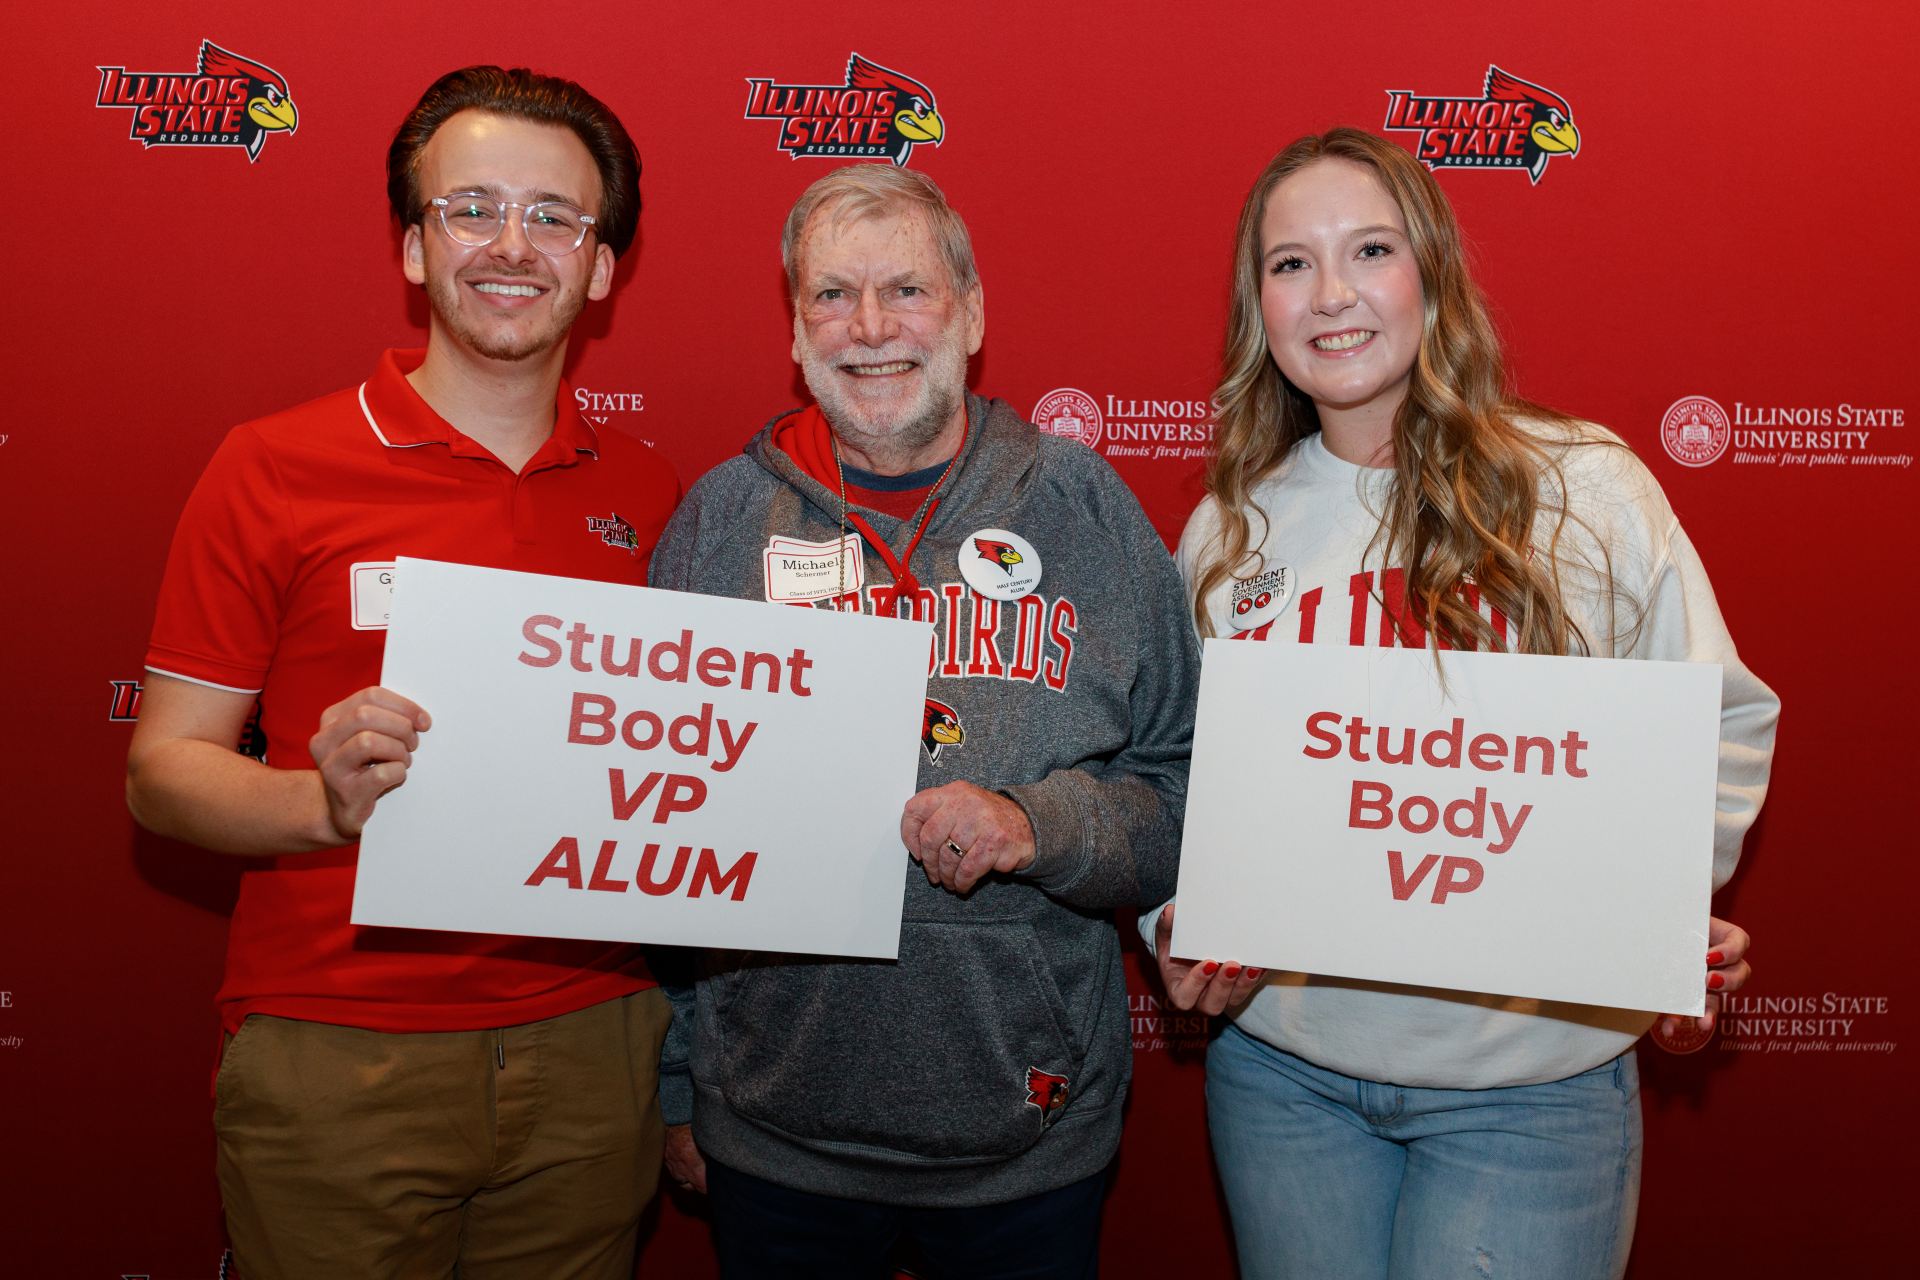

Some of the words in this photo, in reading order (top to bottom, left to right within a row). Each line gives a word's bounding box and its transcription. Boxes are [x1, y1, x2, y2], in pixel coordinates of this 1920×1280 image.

[100, 69, 251, 105] ILLINOIS
[748, 81, 899, 118] ILLINOIS
[1387, 92, 1535, 129] ILLINOIS
[135, 104, 245, 136] STATE
[783, 116, 893, 148] STATE
[159, 134, 240, 143] REDBIRDS
[806, 145, 887, 154] REDBIRDS
[1421, 128, 1529, 159] STATE
[1444, 156, 1523, 166] REDBIRDS
[575, 388, 643, 411] STATE
[1106, 394, 1206, 418] ILLINOIS
[1734, 402, 1832, 426] ILLINOIS
[1837, 403, 1904, 427] STATE
[1106, 423, 1215, 441] UNIVERSI
[1734, 431, 1869, 449] UNIVERSITY
[1153, 445, 1180, 460] first
[1779, 452, 1807, 466] first
[1808, 453, 1848, 467] public
[1851, 453, 1914, 467] university
[783, 557, 840, 570] Michael
[1009, 578, 1033, 587] CENTURY
[1232, 574, 1286, 598] GOVERNMENT
[1233, 567, 1287, 591] STUDENT
[1231, 582, 1285, 603] ASSOCIATION'S
[517, 614, 813, 697] Student
[567, 691, 758, 772] Body
[1302, 711, 1588, 778] Student
[608, 767, 707, 824] VP
[1348, 780, 1534, 854] Body
[523, 836, 759, 901] ALUM
[1386, 850, 1484, 904] VP
[1721, 992, 1817, 1014] ILLINOIS
[1821, 992, 1888, 1015] STATE
[1720, 1019, 1854, 1036] UNIVERSITY
[1764, 1041, 1791, 1054] first
[1794, 1041, 1833, 1054] public
[1835, 1042, 1896, 1055] university
